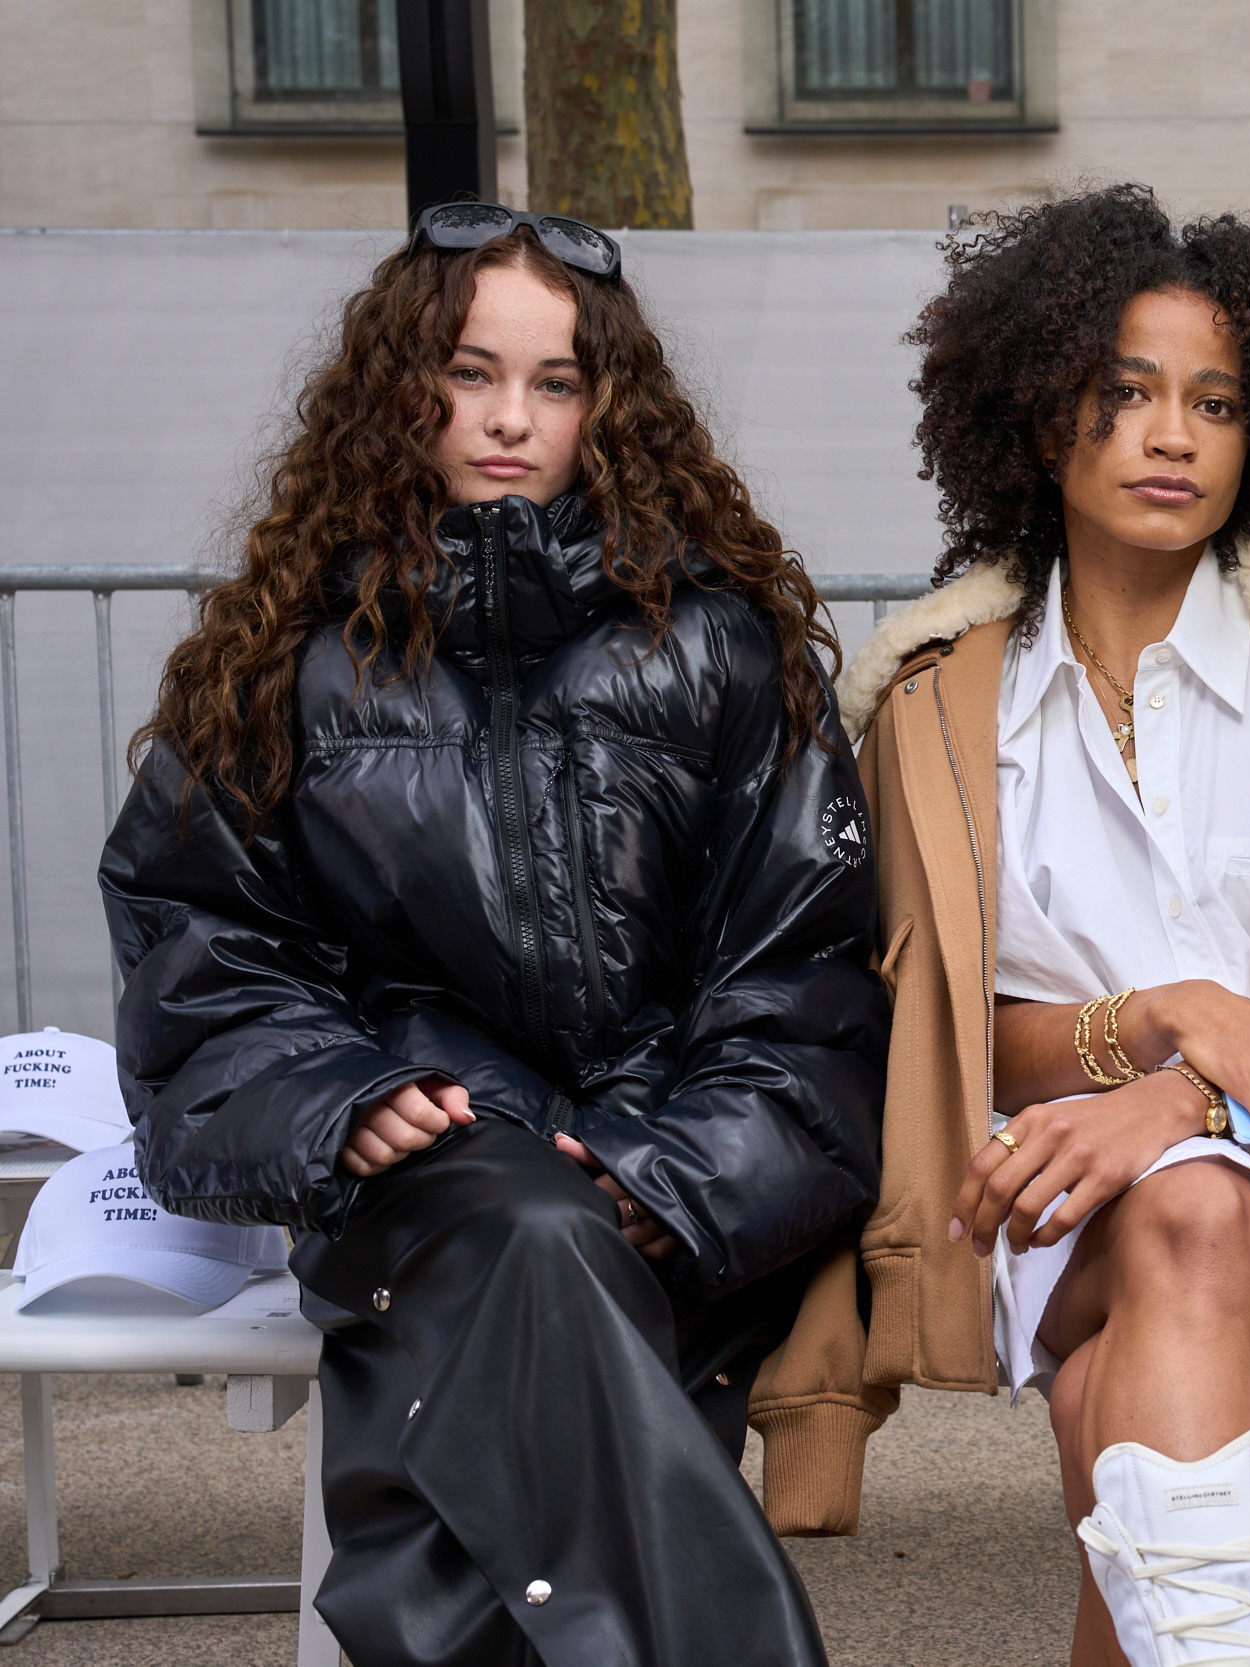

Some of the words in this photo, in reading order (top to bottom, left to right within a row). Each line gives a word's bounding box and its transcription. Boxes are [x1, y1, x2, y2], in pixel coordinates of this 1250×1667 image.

[14, 1049, 67, 1059] ABOUT
[4, 1062, 72, 1075] FUCKING
[14, 1078, 56, 1089] TIME!
[102, 1167, 139, 1181] ABO
[89, 1187, 152, 1203] FUCKI
[104, 1208, 158, 1221] TIME!
